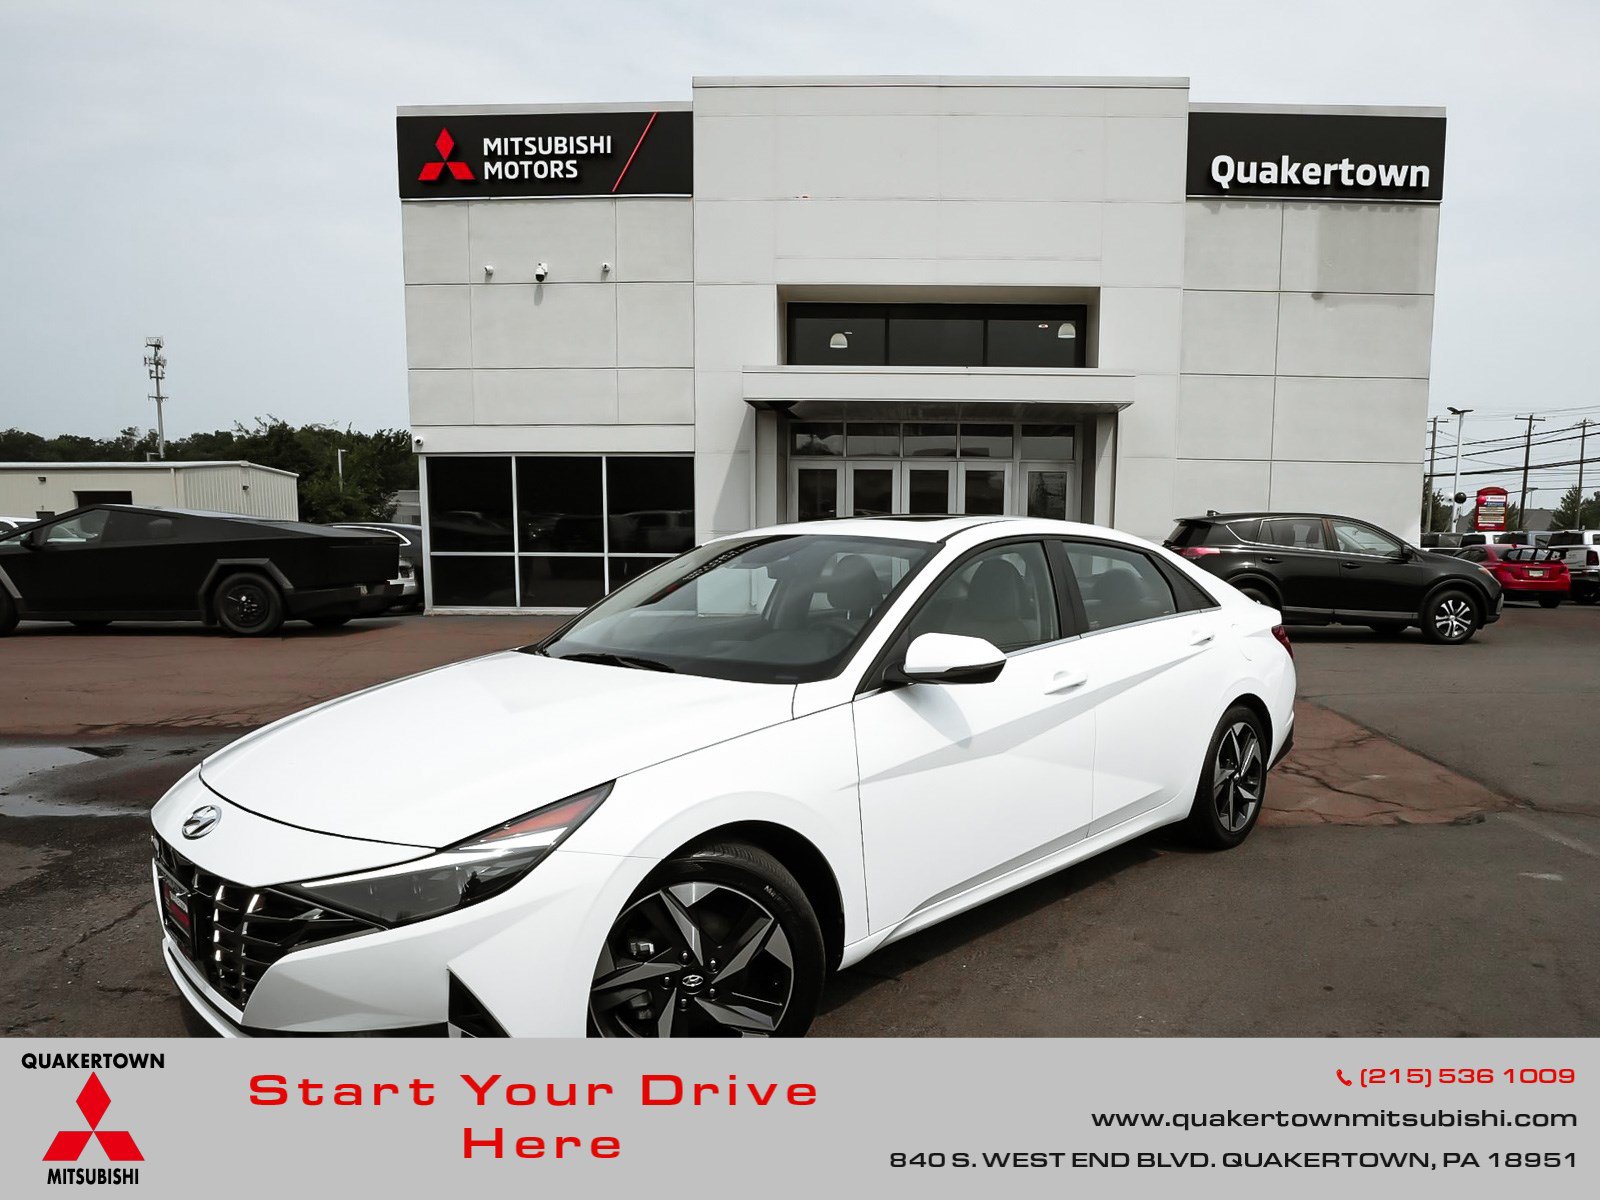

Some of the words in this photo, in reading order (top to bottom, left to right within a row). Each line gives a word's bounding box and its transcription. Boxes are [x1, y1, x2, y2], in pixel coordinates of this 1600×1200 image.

[483, 135, 612, 157] MITSUBISHI
[483, 159, 579, 181] MOTORS
[1210, 154, 1431, 190] Quakertown
